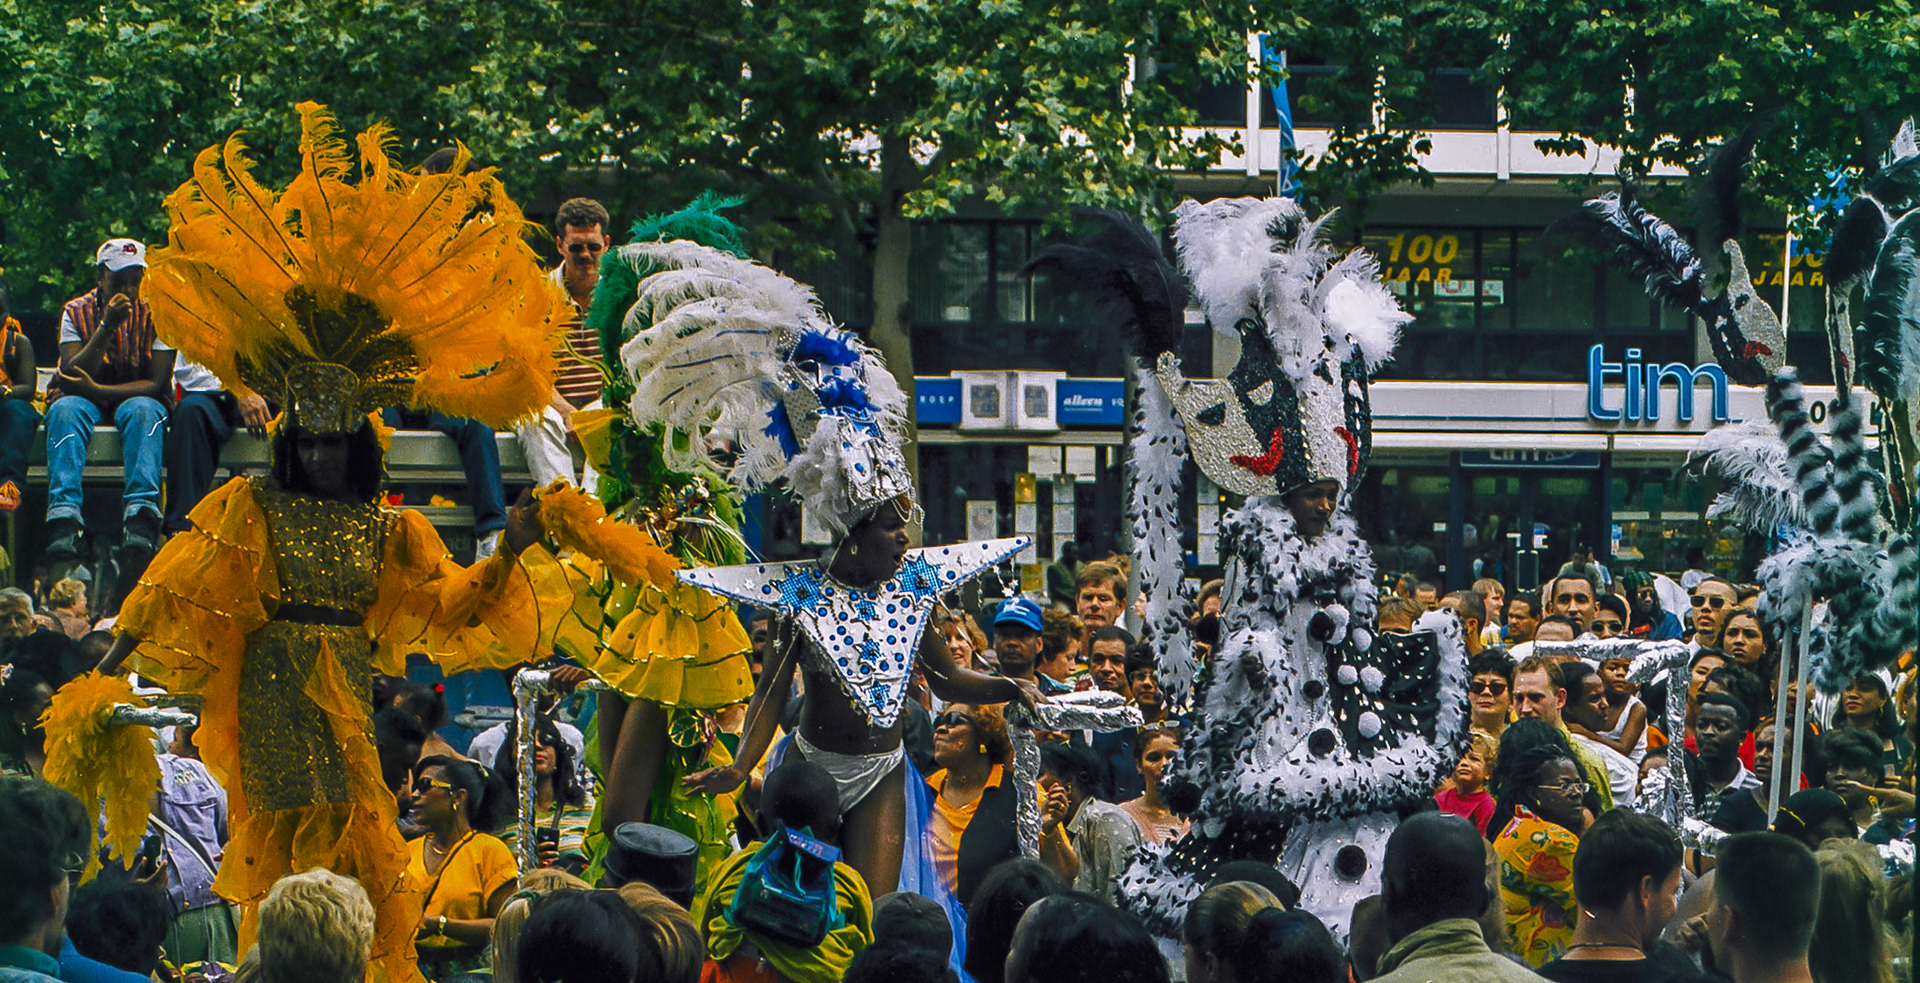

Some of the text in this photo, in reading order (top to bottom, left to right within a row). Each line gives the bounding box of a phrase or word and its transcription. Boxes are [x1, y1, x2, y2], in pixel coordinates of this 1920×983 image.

[1388, 233, 1459, 263] 100
[1380, 266, 1452, 282] JAAR
[1753, 271, 1824, 286] JAAR
[1587, 343, 1728, 422] tim
